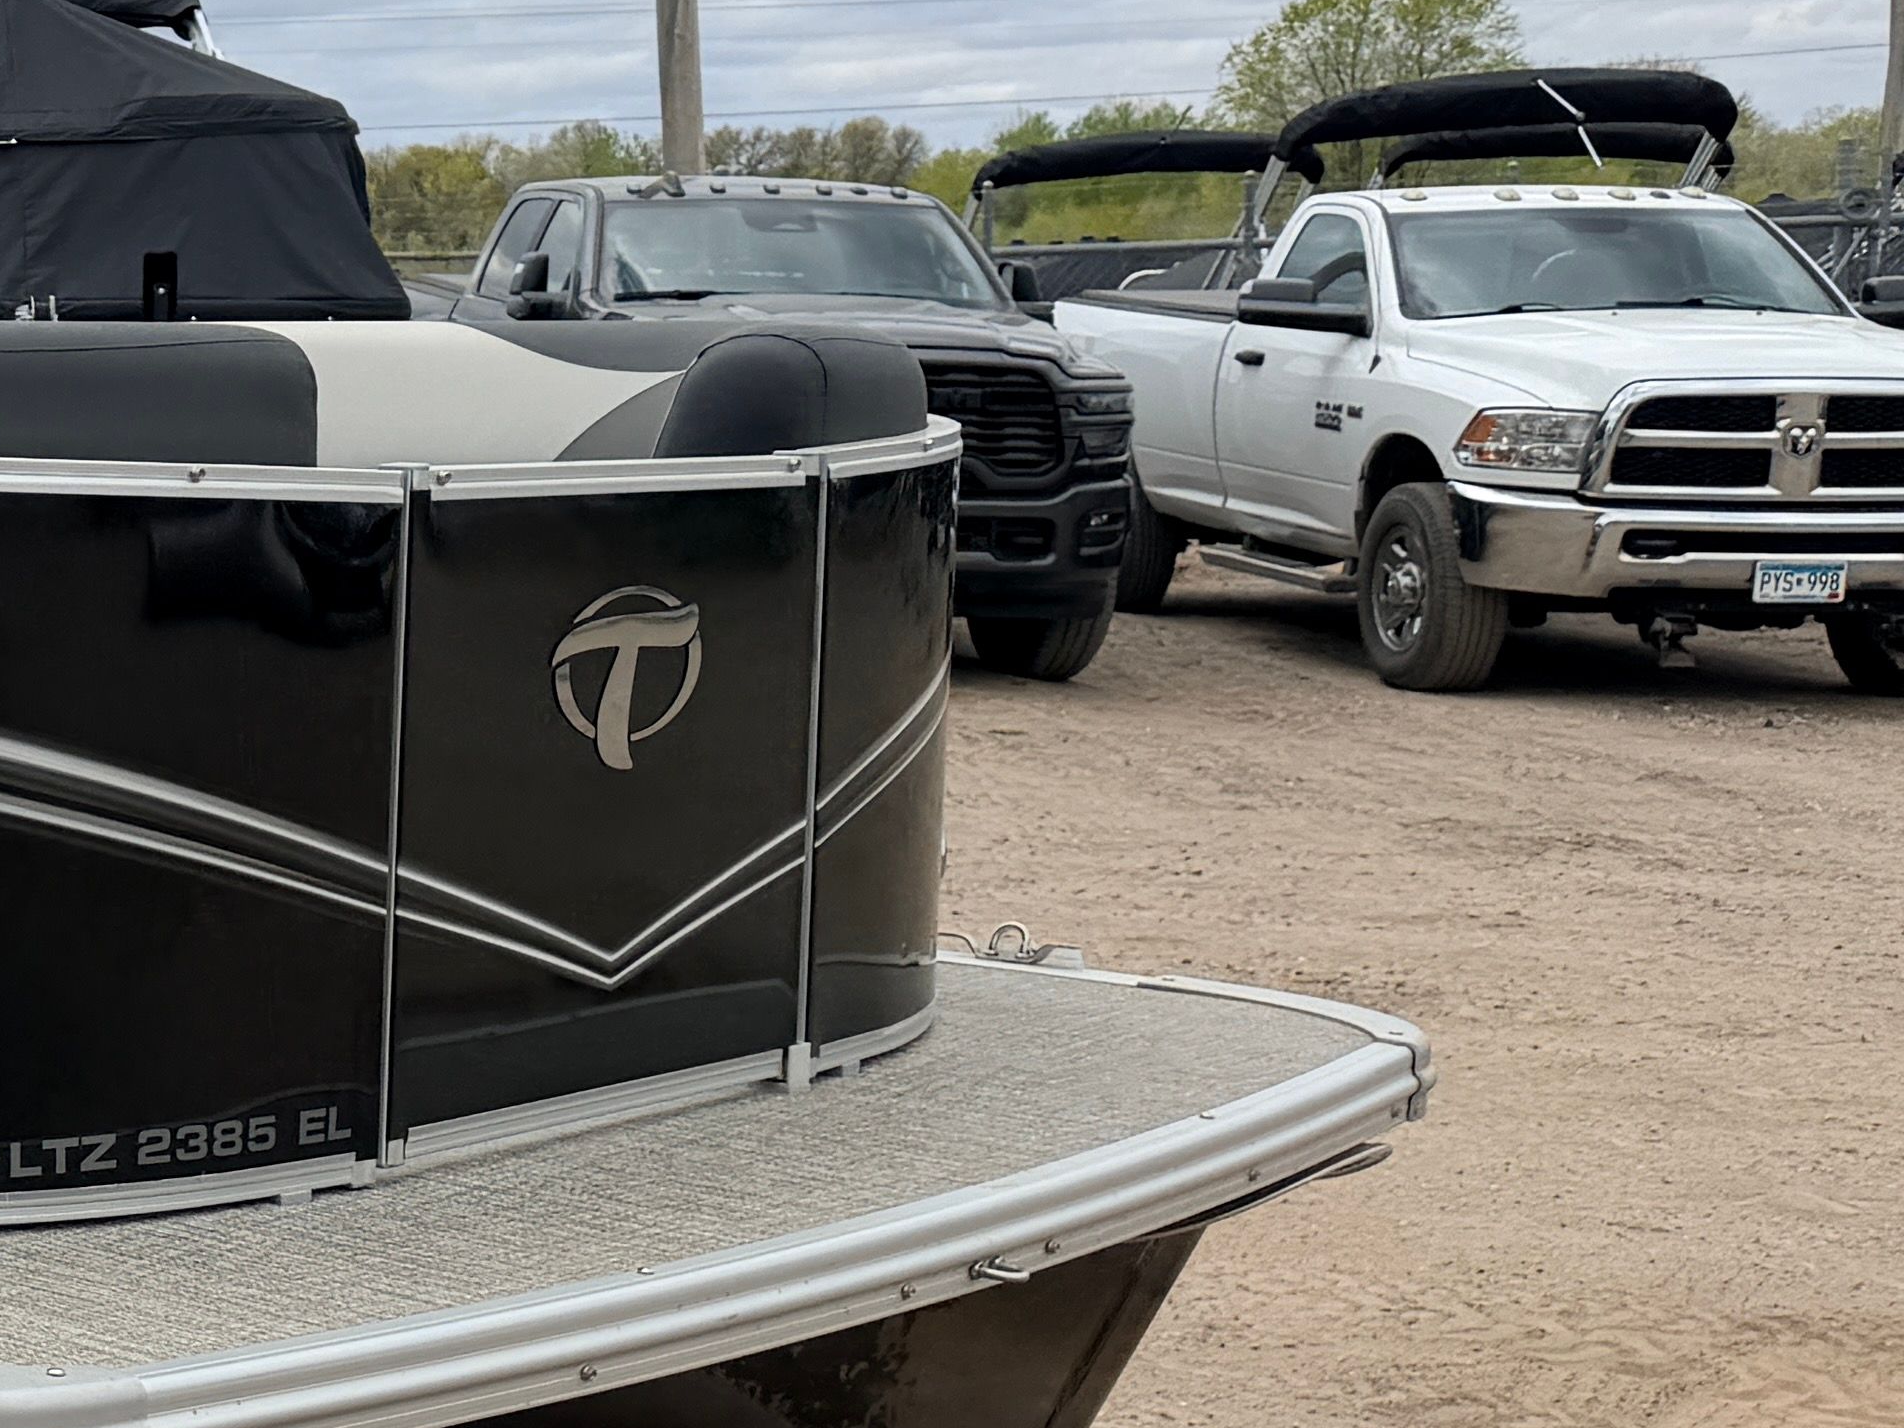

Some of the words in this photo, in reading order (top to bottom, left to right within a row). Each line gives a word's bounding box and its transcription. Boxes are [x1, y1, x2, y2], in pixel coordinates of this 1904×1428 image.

[1760, 572, 1794, 592] PYS
[1808, 572, 1840, 591] 998
[10, 1133, 117, 1178] LTZ
[137, 1115, 277, 1165] 2385
[298, 1106, 352, 1145] EL
